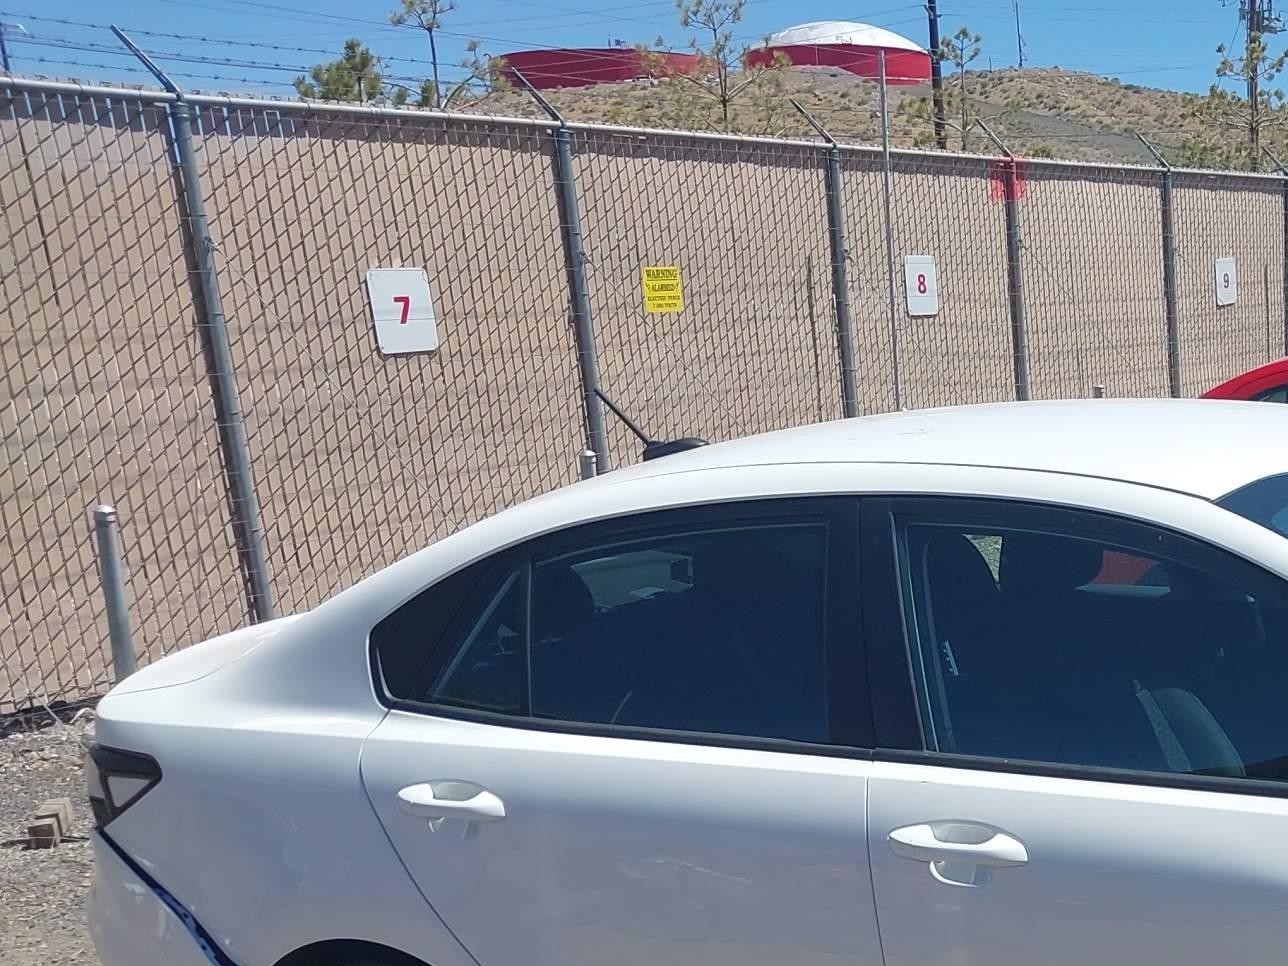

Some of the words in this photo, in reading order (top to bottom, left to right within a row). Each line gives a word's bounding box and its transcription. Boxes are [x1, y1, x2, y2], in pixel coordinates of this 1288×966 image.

[645, 269, 677, 278] WARNING
[1223, 272, 1230, 289] 9
[917, 273, 927, 294] 8
[393, 295, 410, 325] 7
